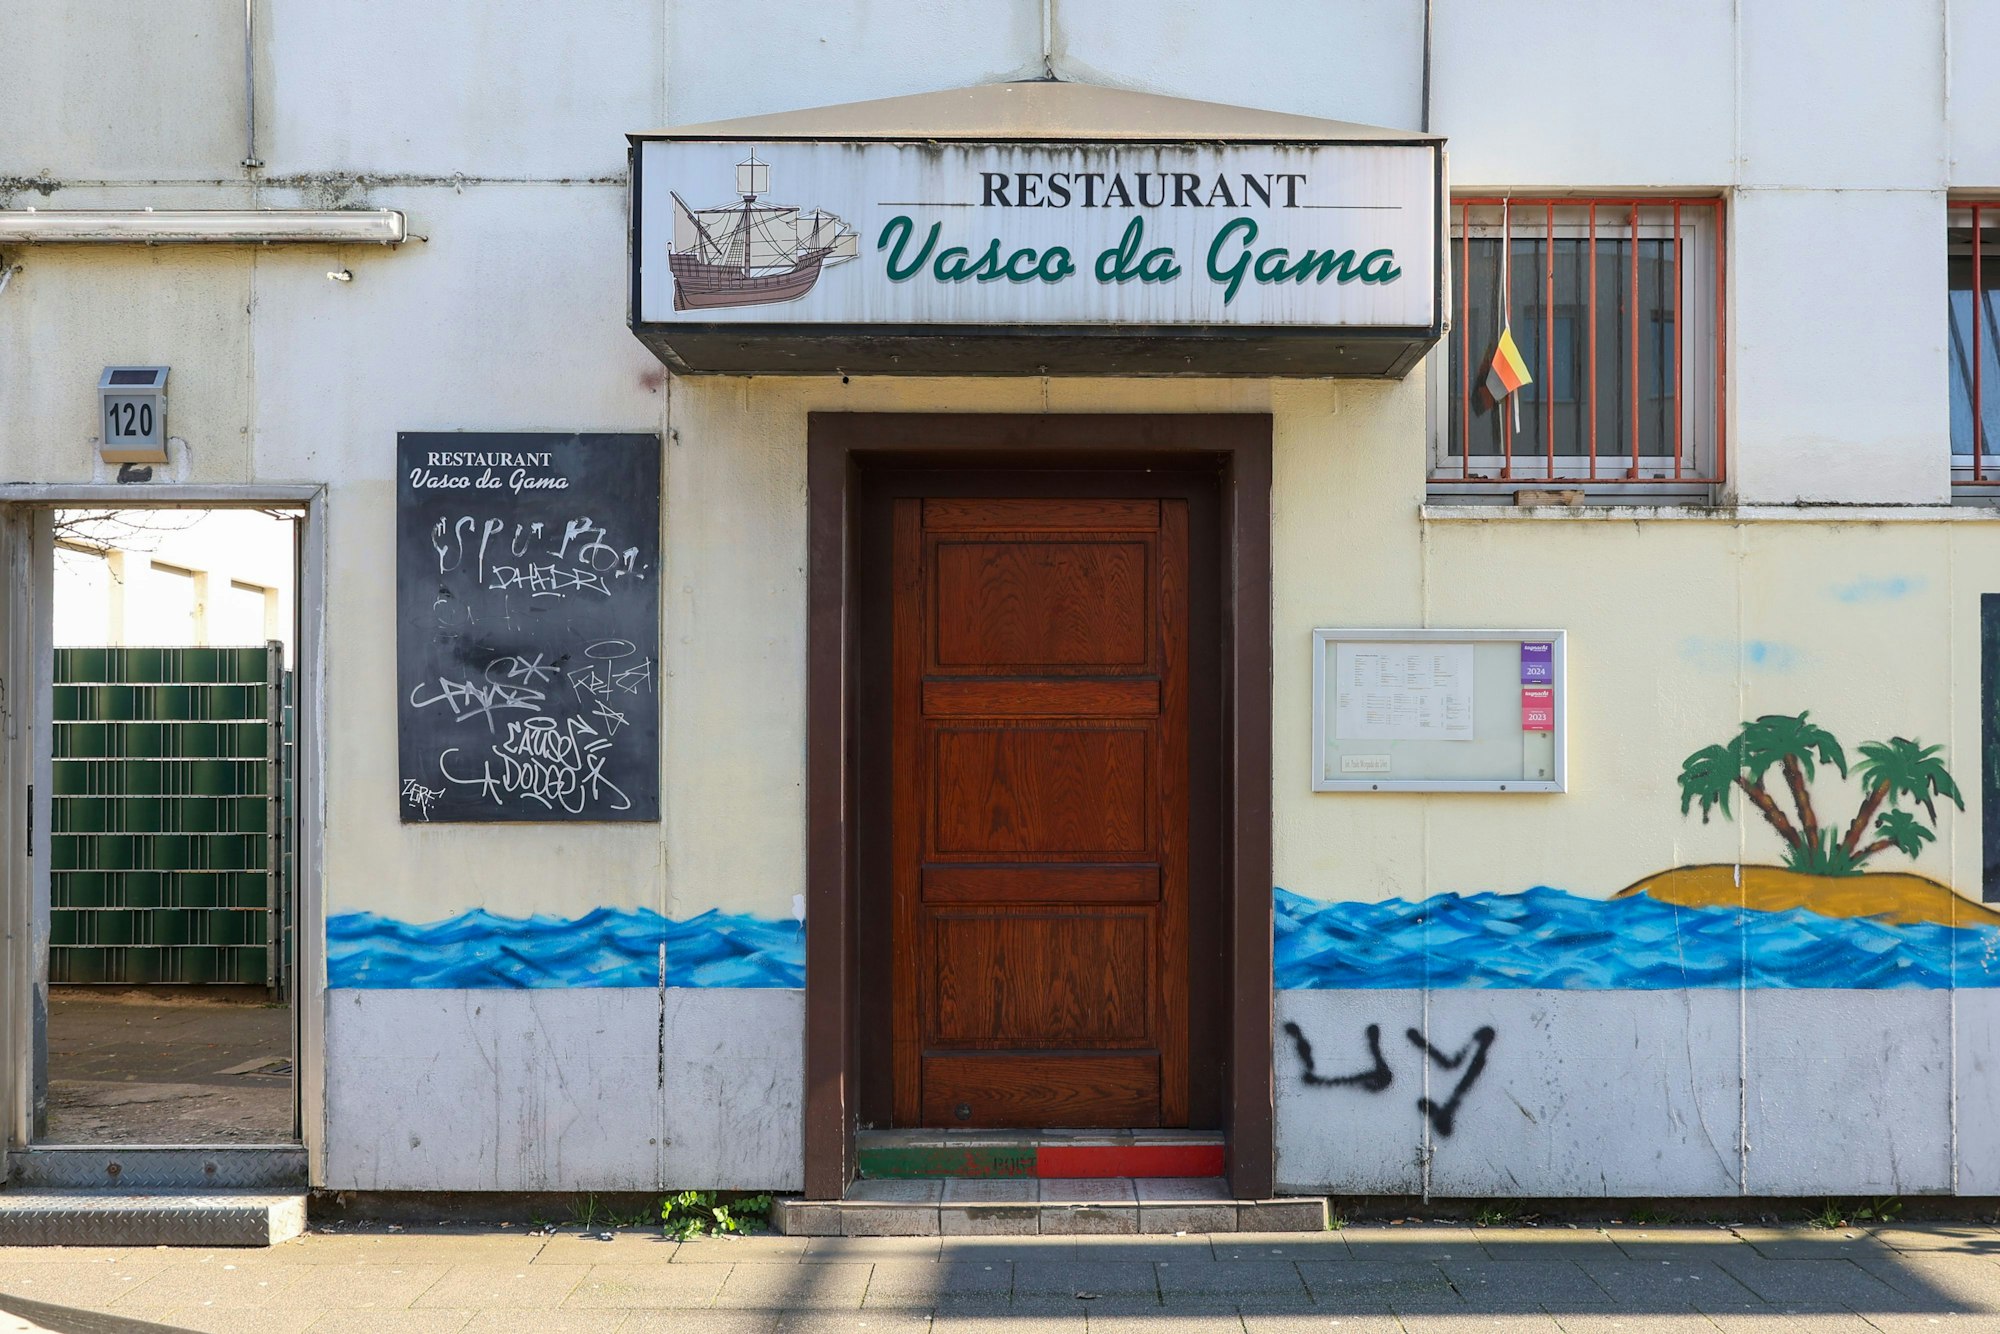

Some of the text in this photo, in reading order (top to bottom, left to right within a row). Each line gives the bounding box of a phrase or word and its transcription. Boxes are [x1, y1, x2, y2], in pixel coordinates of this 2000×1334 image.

[979, 172, 1307, 209] RESTAURANT
[877, 215, 1402, 307] Vasco da Gama
[109, 402, 153, 436] 120
[427, 452, 552, 467] RESTAURANT
[409, 467, 570, 495] Vasco da Gama
